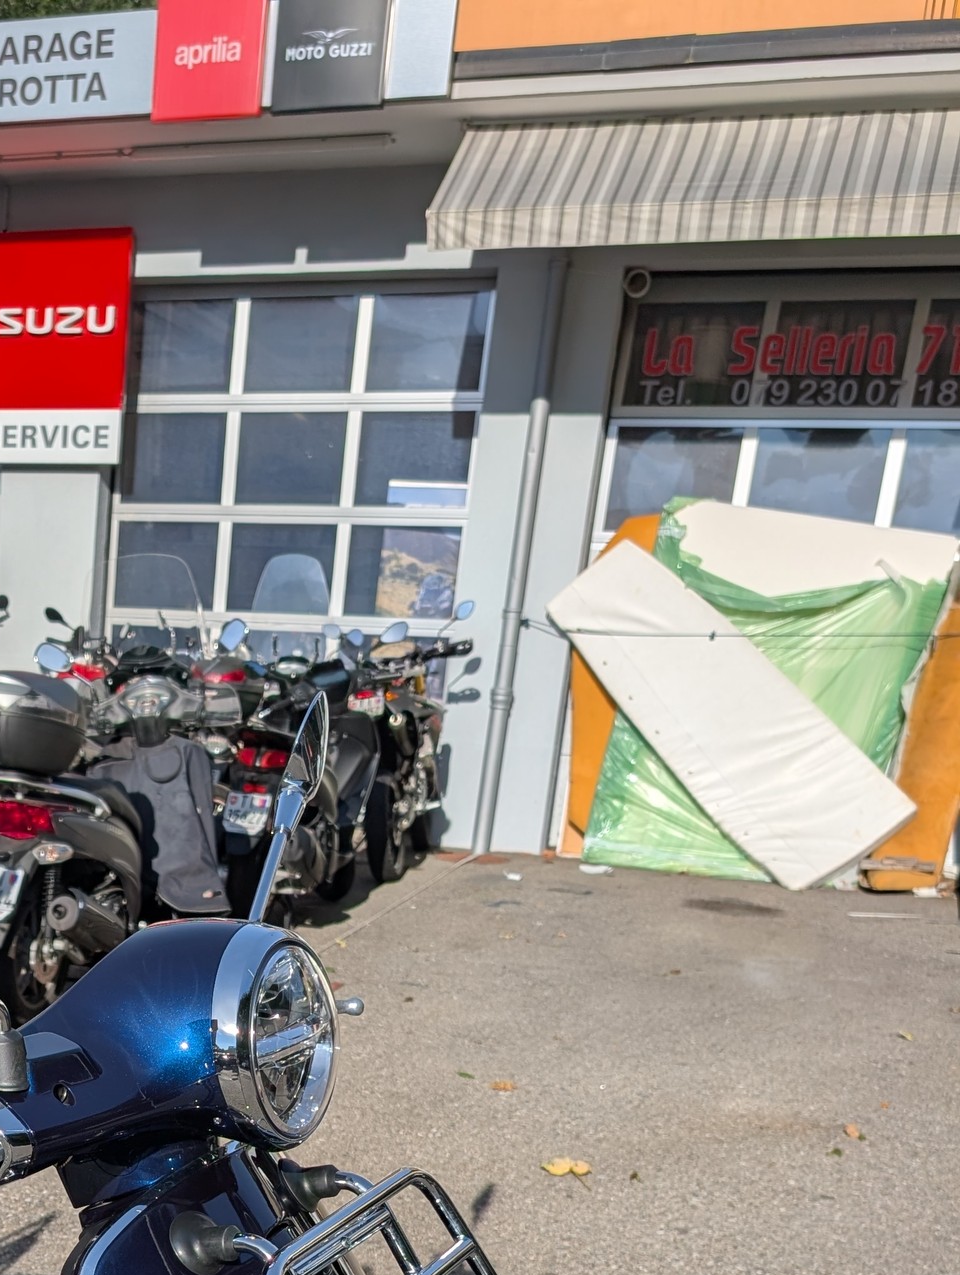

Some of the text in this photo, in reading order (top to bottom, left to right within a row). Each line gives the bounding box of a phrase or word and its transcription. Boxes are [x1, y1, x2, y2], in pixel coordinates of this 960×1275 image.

[175, 36, 241, 69] aprilia
[285, 42, 372, 62] MOTO GUZZI
[642, 327, 695, 377] La
[727, 324, 897, 376] Selleria
[640, 379, 959, 407] Tel. 079 230 07 18
